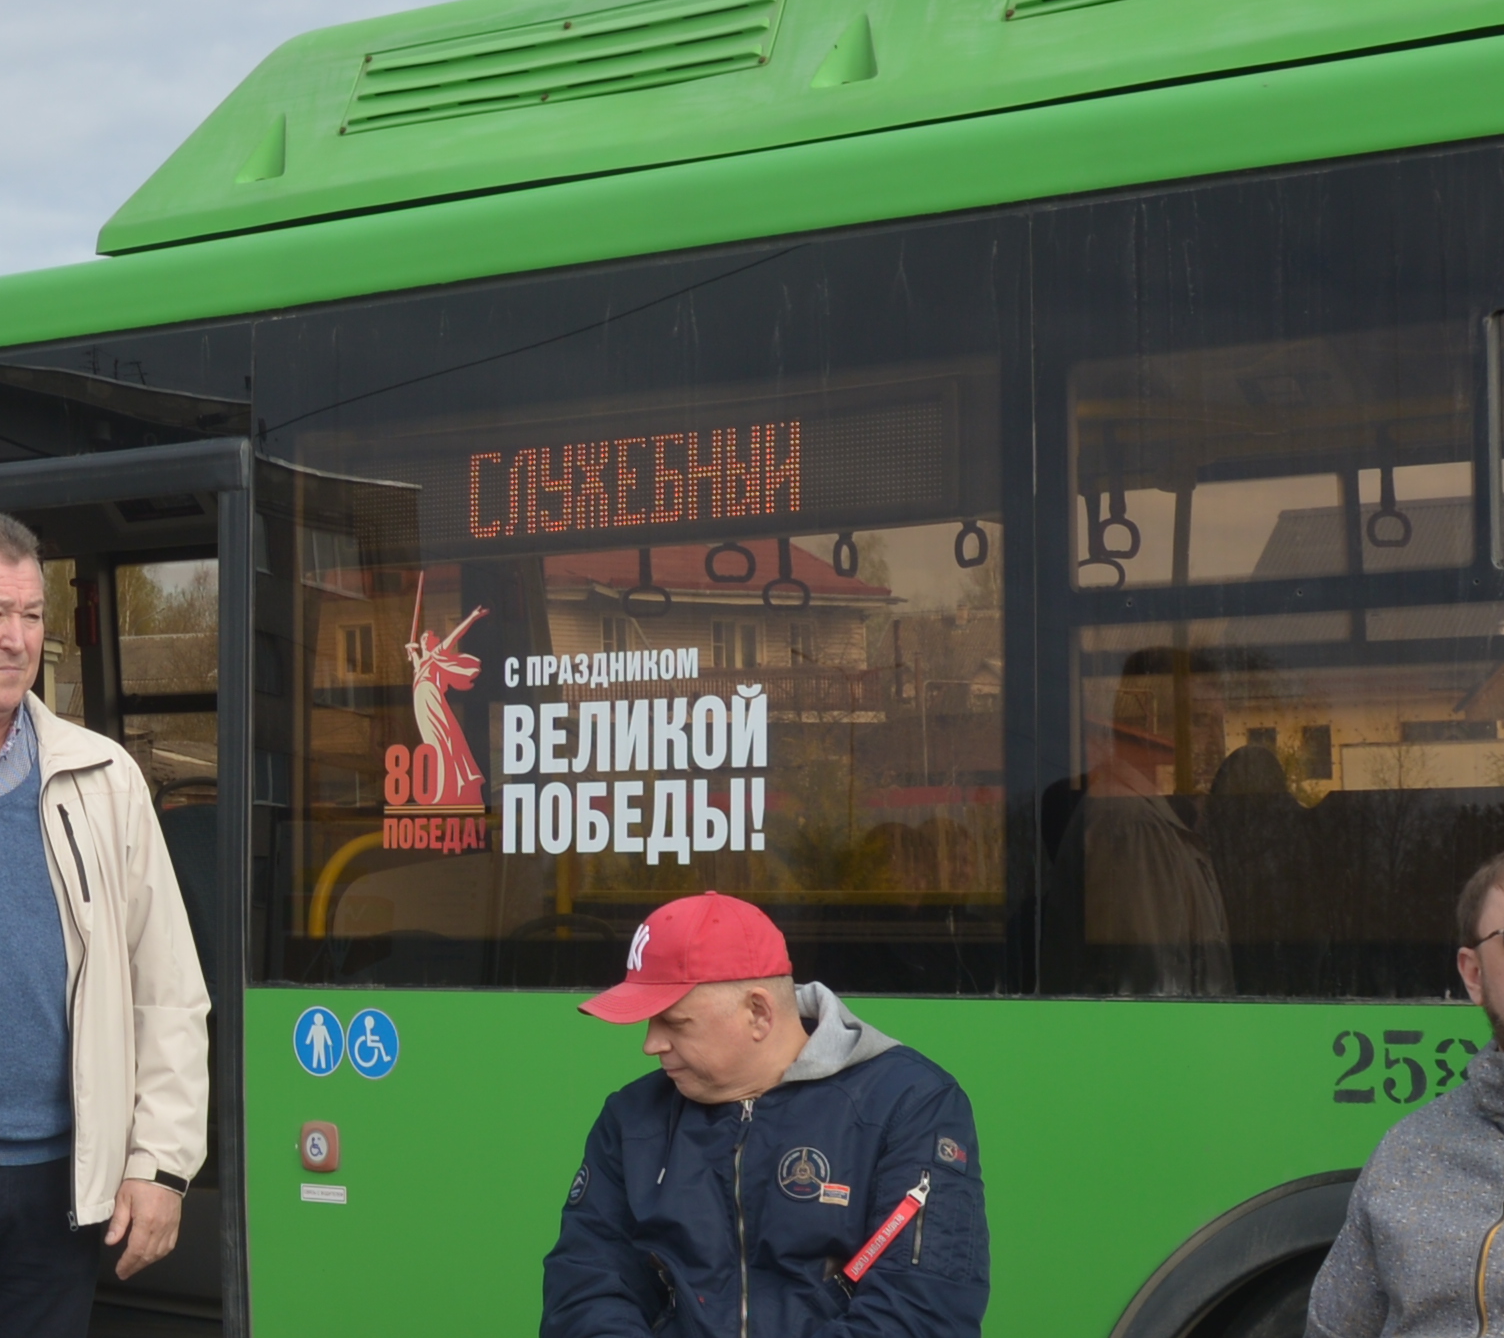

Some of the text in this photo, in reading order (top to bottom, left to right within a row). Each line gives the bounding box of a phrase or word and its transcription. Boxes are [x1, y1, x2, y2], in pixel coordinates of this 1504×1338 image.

[469, 419, 802, 539] СЛУЖЕБНЫЙ
[504, 647, 699, 689] С ПРАЗДНИКОМ
[503, 684, 768, 775] ВЕЛИКОЙ
[385, 743, 439, 805] 80
[383, 816, 486, 855] ПОБЕДА!
[502, 777, 766, 865] ПОБЕДЫ!
[850, 1213, 905, 1276] REMOVE BEFORE FLIGHT
